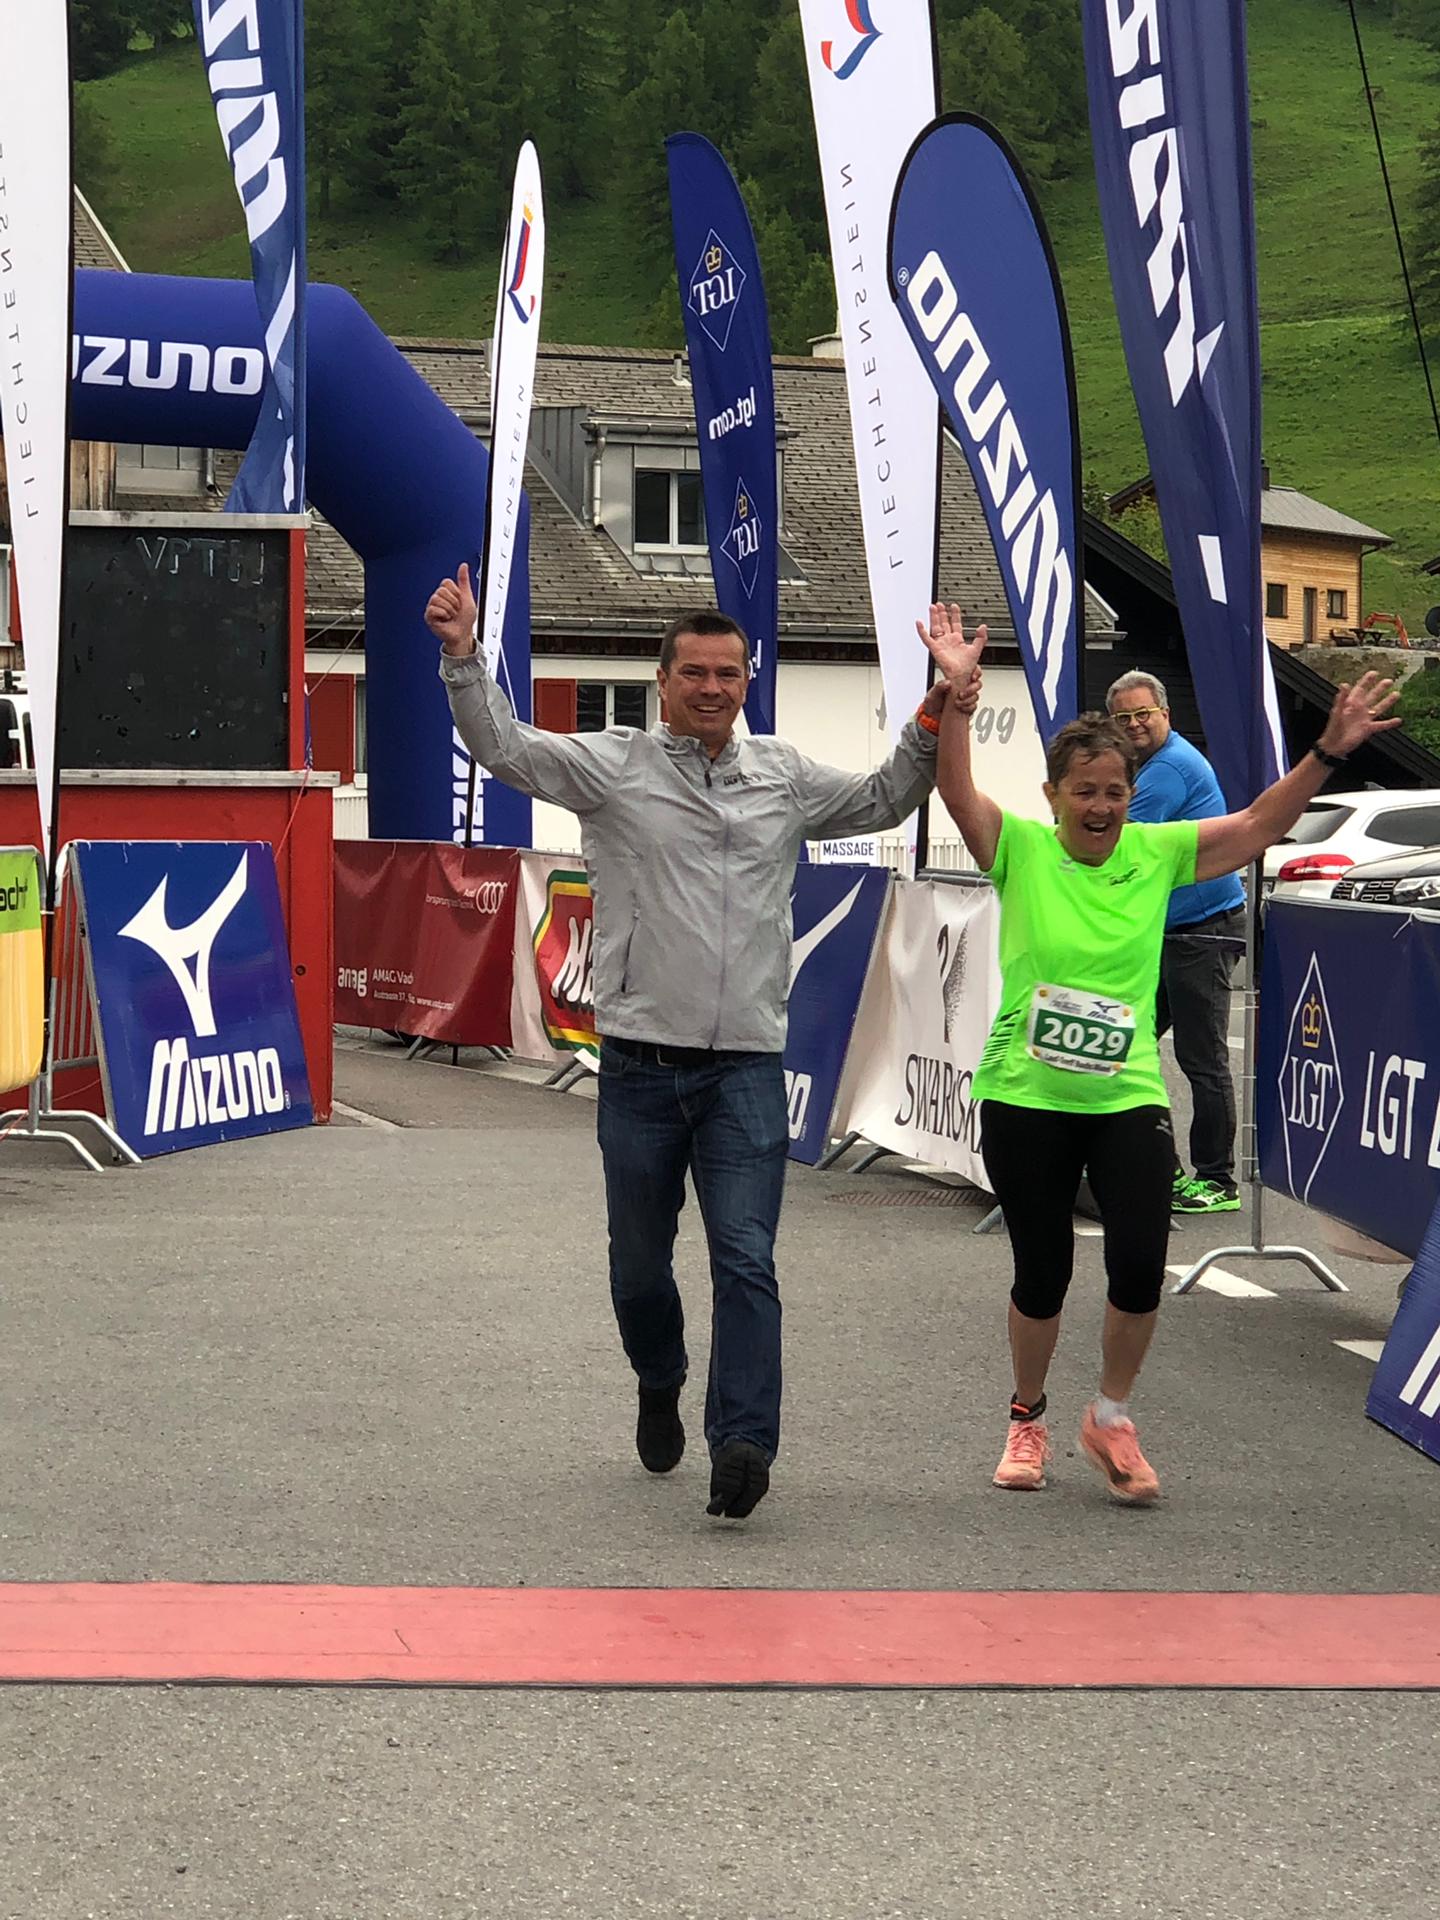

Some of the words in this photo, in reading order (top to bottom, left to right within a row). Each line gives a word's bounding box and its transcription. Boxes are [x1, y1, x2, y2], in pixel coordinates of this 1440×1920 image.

[823, 842, 875, 856] MASSAGE
[1040, 1017, 1127, 1057] 2029
[144, 1037, 284, 1136] MIZUNO
[1288, 1055, 1333, 1132] LGT
[1360, 1050, 1426, 1160] LGT
